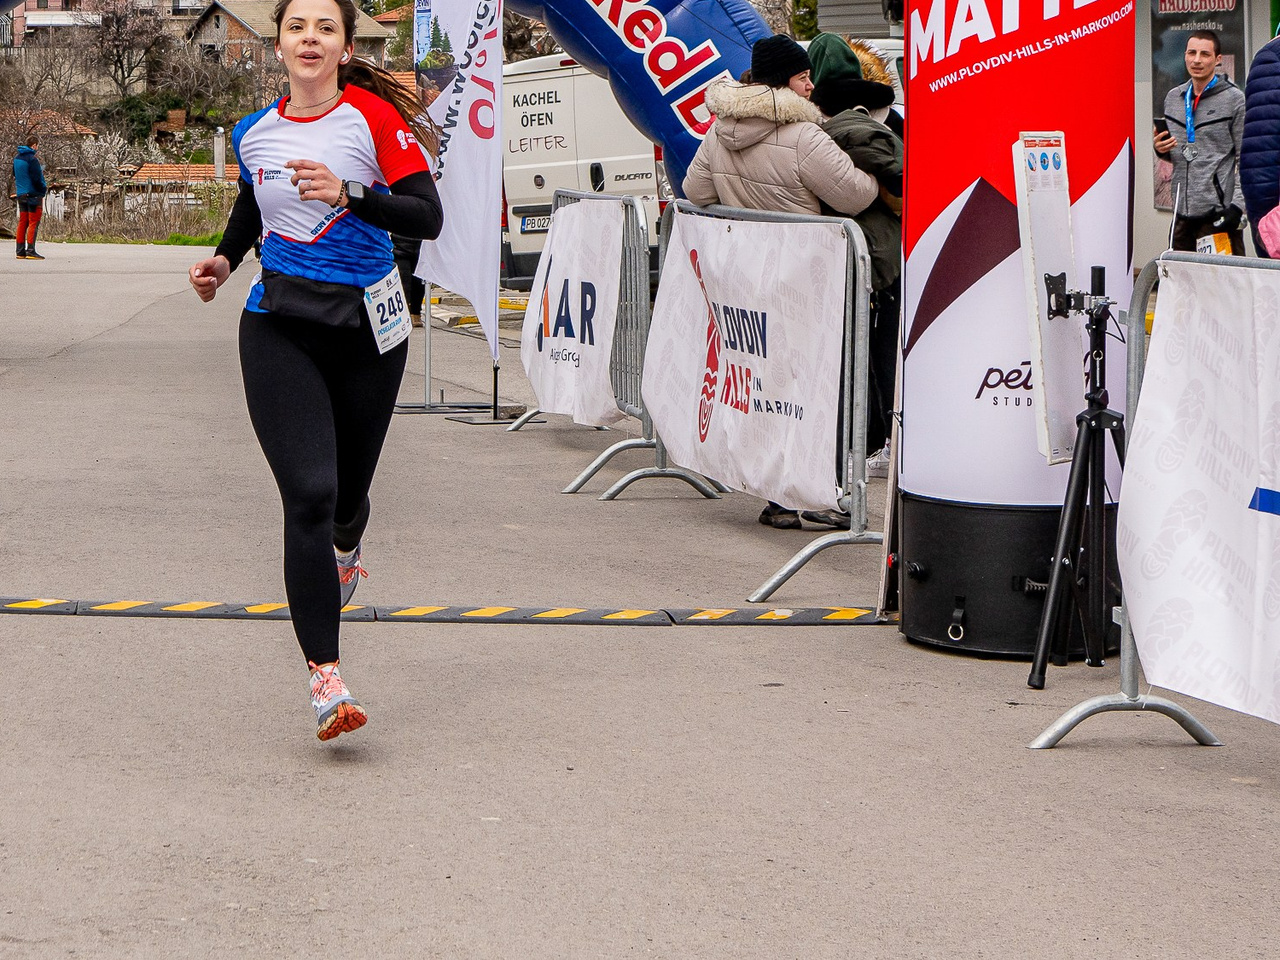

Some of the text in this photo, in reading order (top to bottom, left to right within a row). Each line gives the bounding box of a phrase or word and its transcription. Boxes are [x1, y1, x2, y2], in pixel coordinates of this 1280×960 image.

[928, 0, 1133, 93] WWW.PLOVDIV-HILLS-IN-MARKOVO.COM
[512, 91, 561, 108] KACHEL
[521, 111, 553, 127] ÖFEN
[508, 135, 568, 154] LEITER
[614, 172, 652, 182] DUCATO
[376, 290, 404, 326] 248
[753, 377, 762, 391] IN
[753, 398, 803, 421] MARKOVO
[992, 396, 1033, 407] STUD
